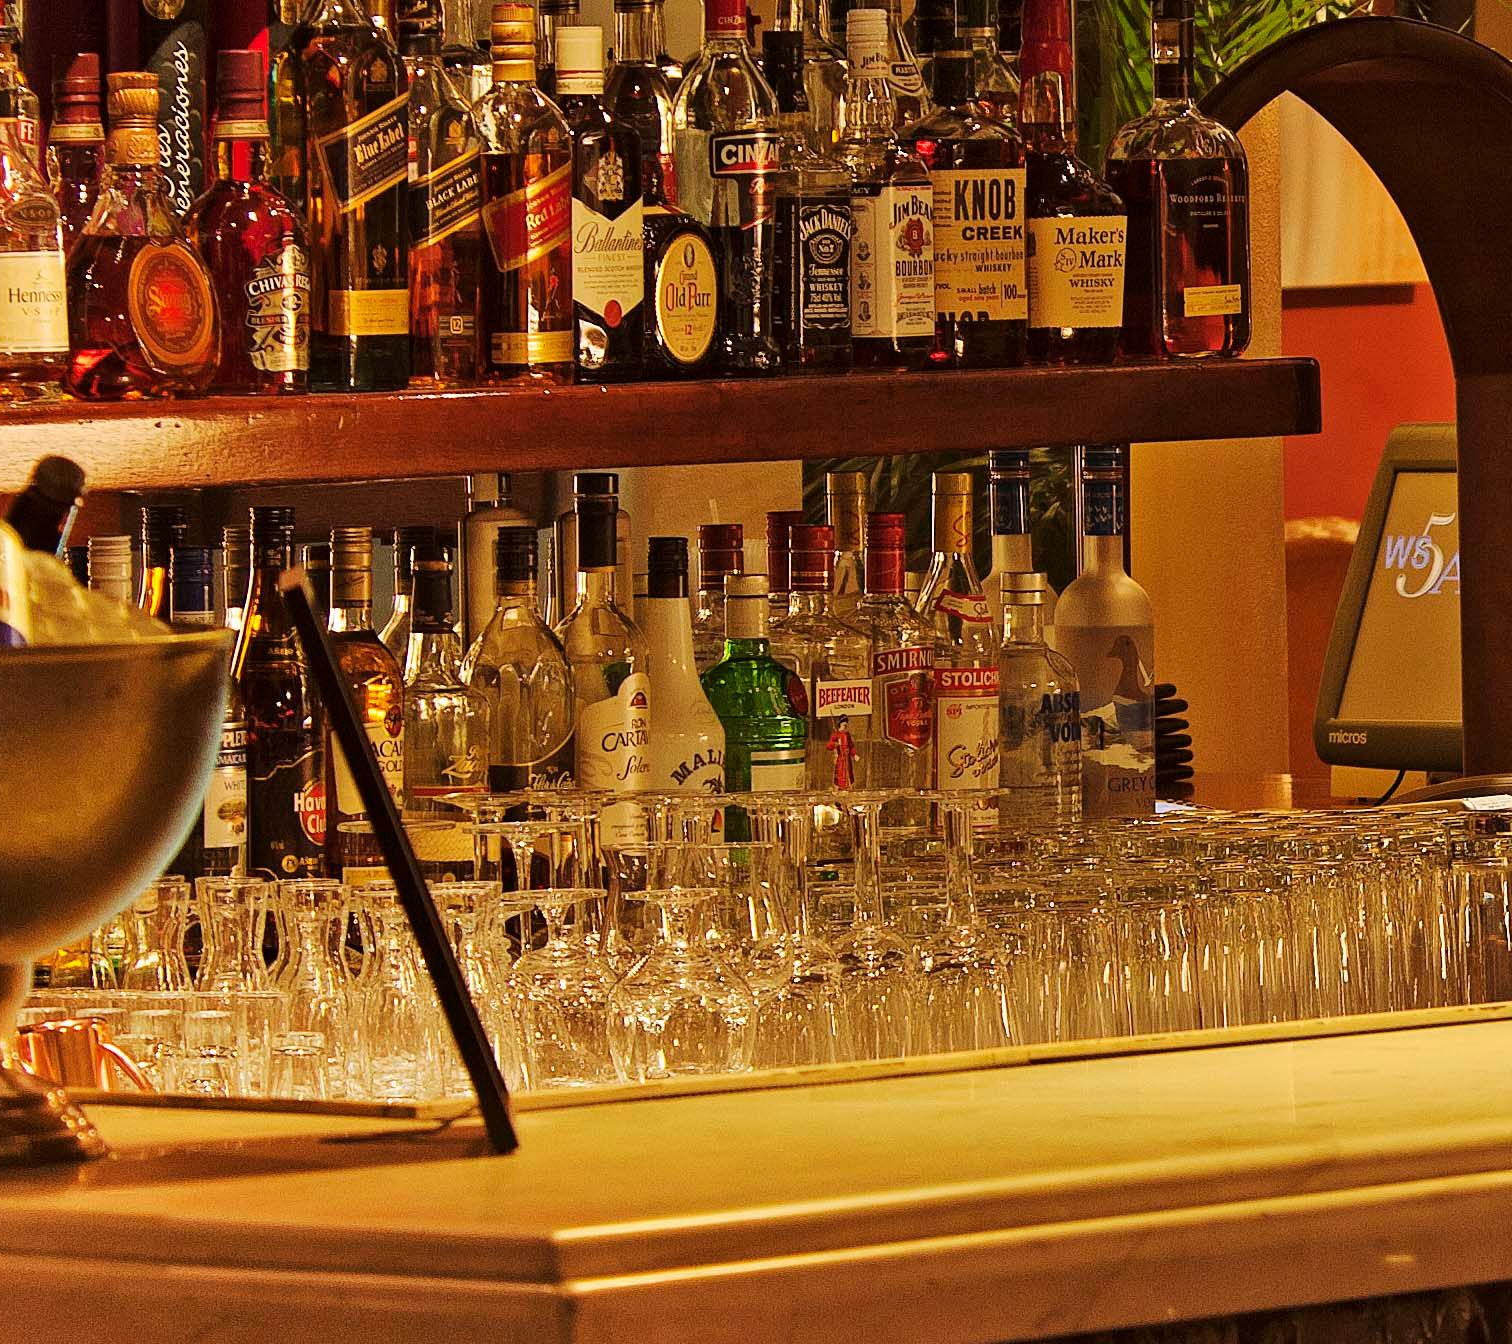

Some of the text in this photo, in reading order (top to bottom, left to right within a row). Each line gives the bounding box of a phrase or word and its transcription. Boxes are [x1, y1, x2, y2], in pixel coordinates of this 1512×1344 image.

[353, 122, 406, 164] Blue Label
[426, 189, 456, 212] BLACK
[954, 178, 1016, 221] KNOB
[1169, 193, 1214, 204] WOODFORD
[525, 209, 548, 232] Red
[888, 201, 911, 230] JIM
[799, 215, 822, 241] JACK
[961, 225, 1023, 241] CREEK
[1054, 227, 1124, 246] Maker's
[960, 247, 995, 263] straight
[1079, 249, 1123, 269] Mark
[895, 260, 934, 277] BOURBON
[975, 263, 1012, 272] WHISKEY
[248, 273, 294, 297] CHIVAS
[809, 282, 844, 292] WHISKEY
[1003, 284, 1018, 300] 100
[1069, 277, 1115, 289] WHISKY
[666, 282, 686, 312] Old
[687, 282, 711, 312] Parr
[819, 686, 871, 708] BEEFEATER
[631, 718, 648, 730] RON
[1328, 729, 1368, 744] micros
[1108, 776, 1146, 793] GREY
